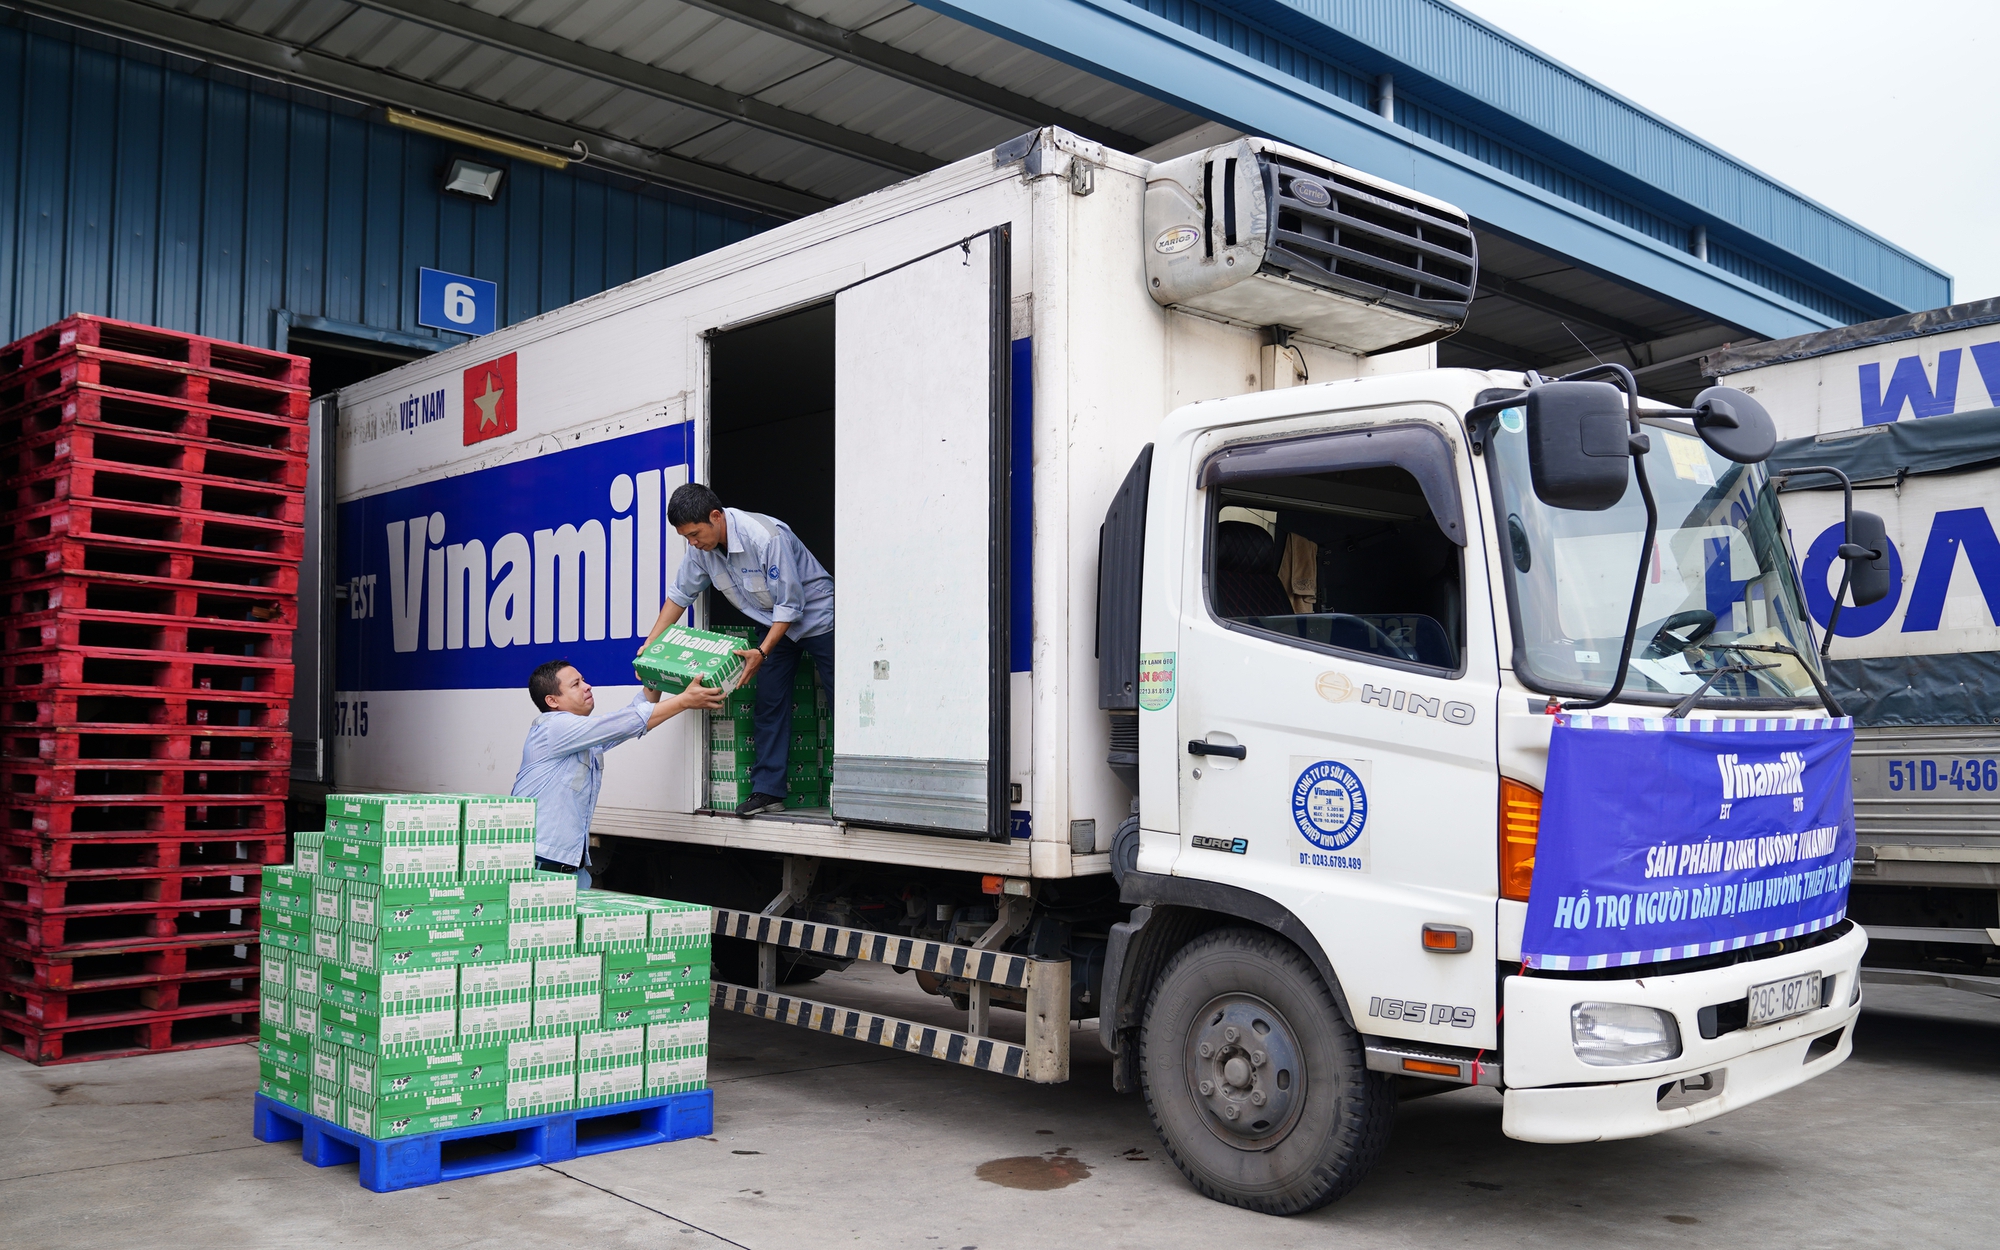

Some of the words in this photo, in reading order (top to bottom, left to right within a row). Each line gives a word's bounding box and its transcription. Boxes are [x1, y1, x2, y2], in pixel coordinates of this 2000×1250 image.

[1298, 184, 1325, 200] Carrier
[1158, 234, 1191, 248] XARIOS
[443, 282, 476, 325] 6
[400, 393, 420, 435] VIỆT
[422, 389, 445, 425] NAM
[350, 574, 377, 619] EST
[661, 628, 734, 656] Vinamilk
[1361, 683, 1476, 726] HINO
[1309, 767, 1321, 781] TY
[1320, 765, 1330, 778] CP
[1717, 752, 1806, 800] Vinamilk
[1889, 759, 1998, 791] 51D-436
[1297, 774, 1314, 796] CÔNG
[1314, 787, 1344, 797] Vinamilk
[1341, 772, 1360, 793] VIỆT
[1350, 790, 1364, 811] NAM
[1719, 803, 1732, 820] EST
[1319, 833, 1335, 847] KHO
[1312, 854, 1362, 870] 0243.6789.489
[1644, 840, 1678, 879] SẢN
[1678, 835, 1723, 876] PHẨM
[1723, 838, 1758, 872] DINH
[429, 887, 465, 898] Vinamilk
[1553, 888, 1591, 930] HỖ
[1596, 891, 1633, 931] TRỢ
[1635, 885, 1689, 925] NGƯỜI
[1690, 883, 1720, 920] DÂN
[1721, 884, 1738, 919] BỊ
[1737, 877, 1764, 913] ẢNH
[1763, 871, 1802, 909] HƯỞNG
[1802, 865, 1826, 900] THIÊN
[428, 928, 464, 940] Vinamilk
[1369, 996, 1427, 1023] 165
[1429, 1004, 1476, 1029] PS
[426, 1052, 463, 1065] Vinamilk
[425, 1093, 462, 1106] Vinamilk
